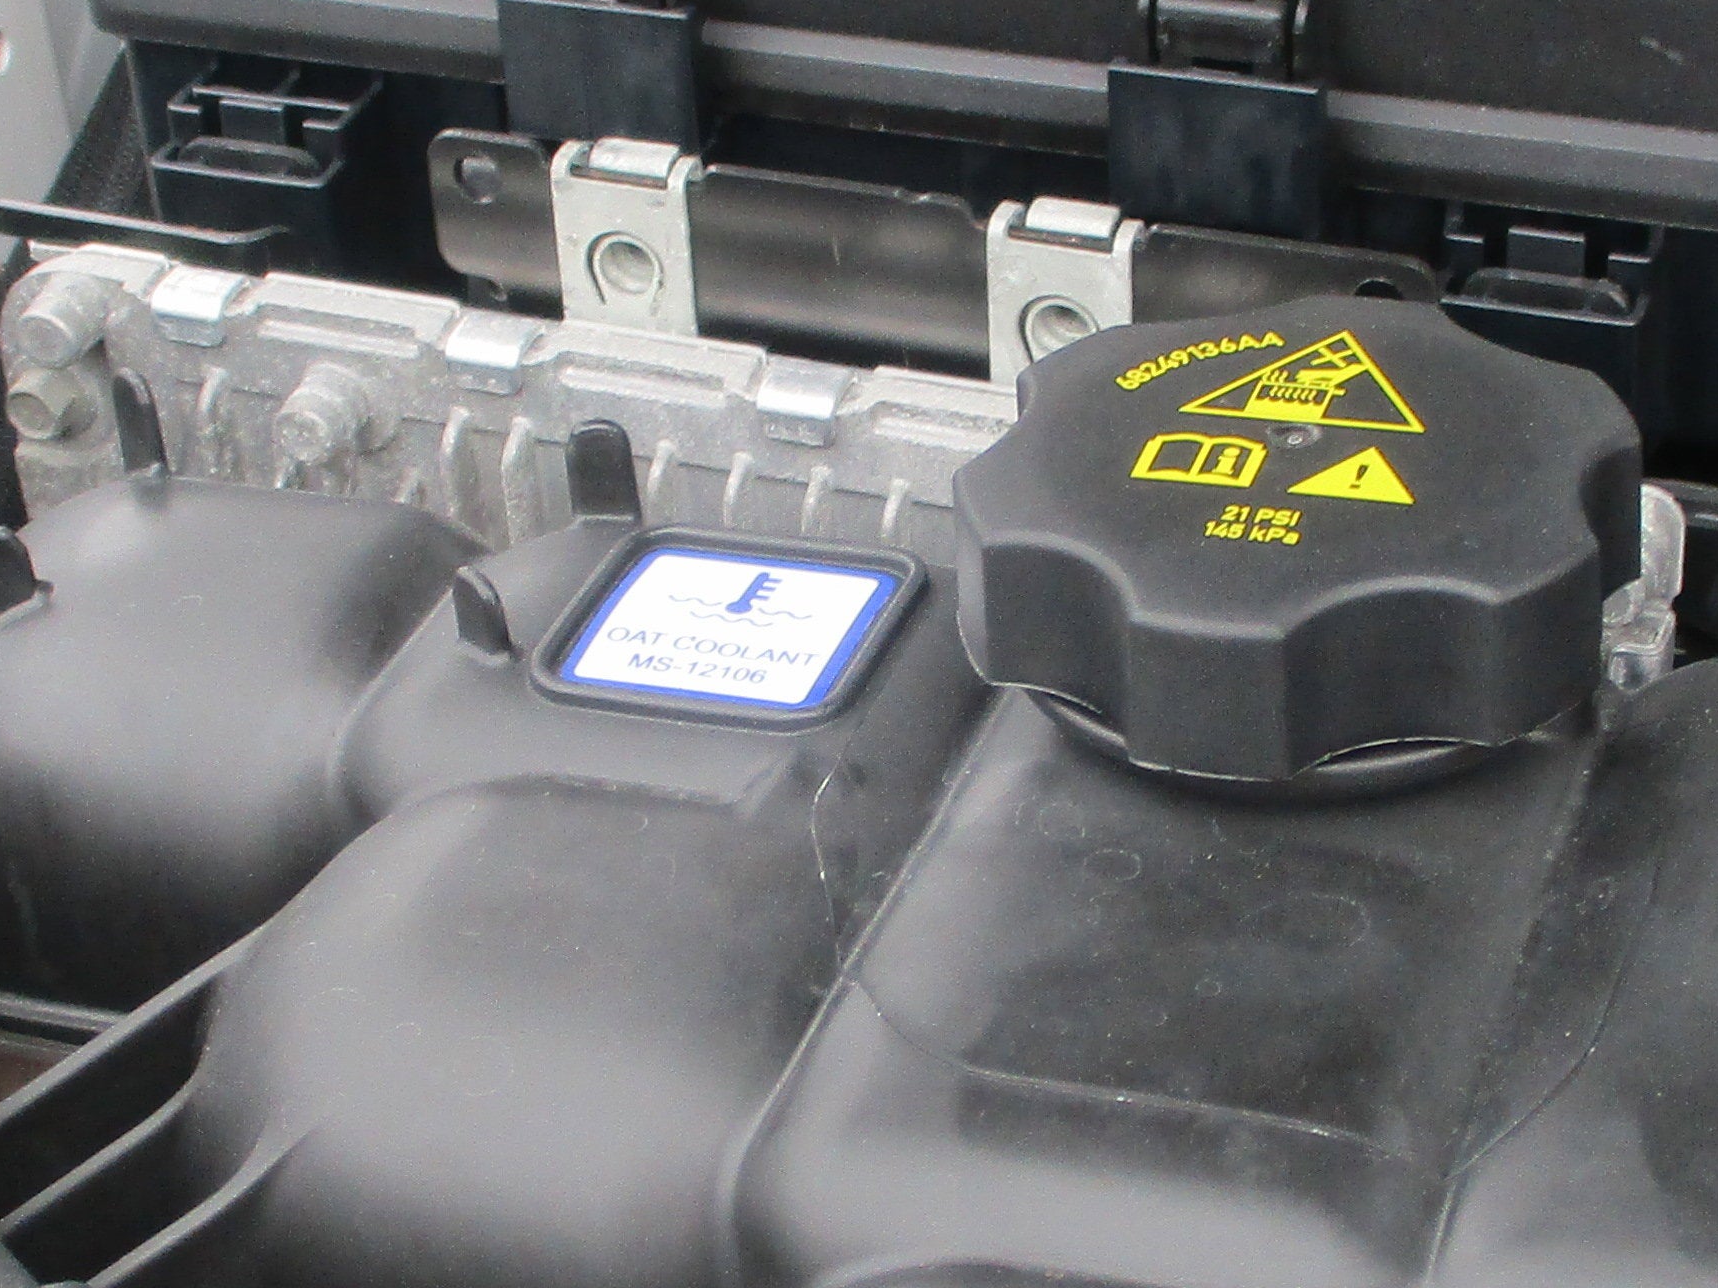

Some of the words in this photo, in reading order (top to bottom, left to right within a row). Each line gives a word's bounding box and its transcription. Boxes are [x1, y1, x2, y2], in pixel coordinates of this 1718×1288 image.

[1115, 330, 1285, 391] 68249136AA
[1220, 504, 1251, 523] 21
[1253, 507, 1301, 528] PSI
[1204, 520, 1246, 540] 145
[1247, 524, 1301, 546] kPa
[607, 627, 667, 646] OAT
[673, 636, 820, 667] COOLANT
[627, 653, 768, 684] MS-12106
